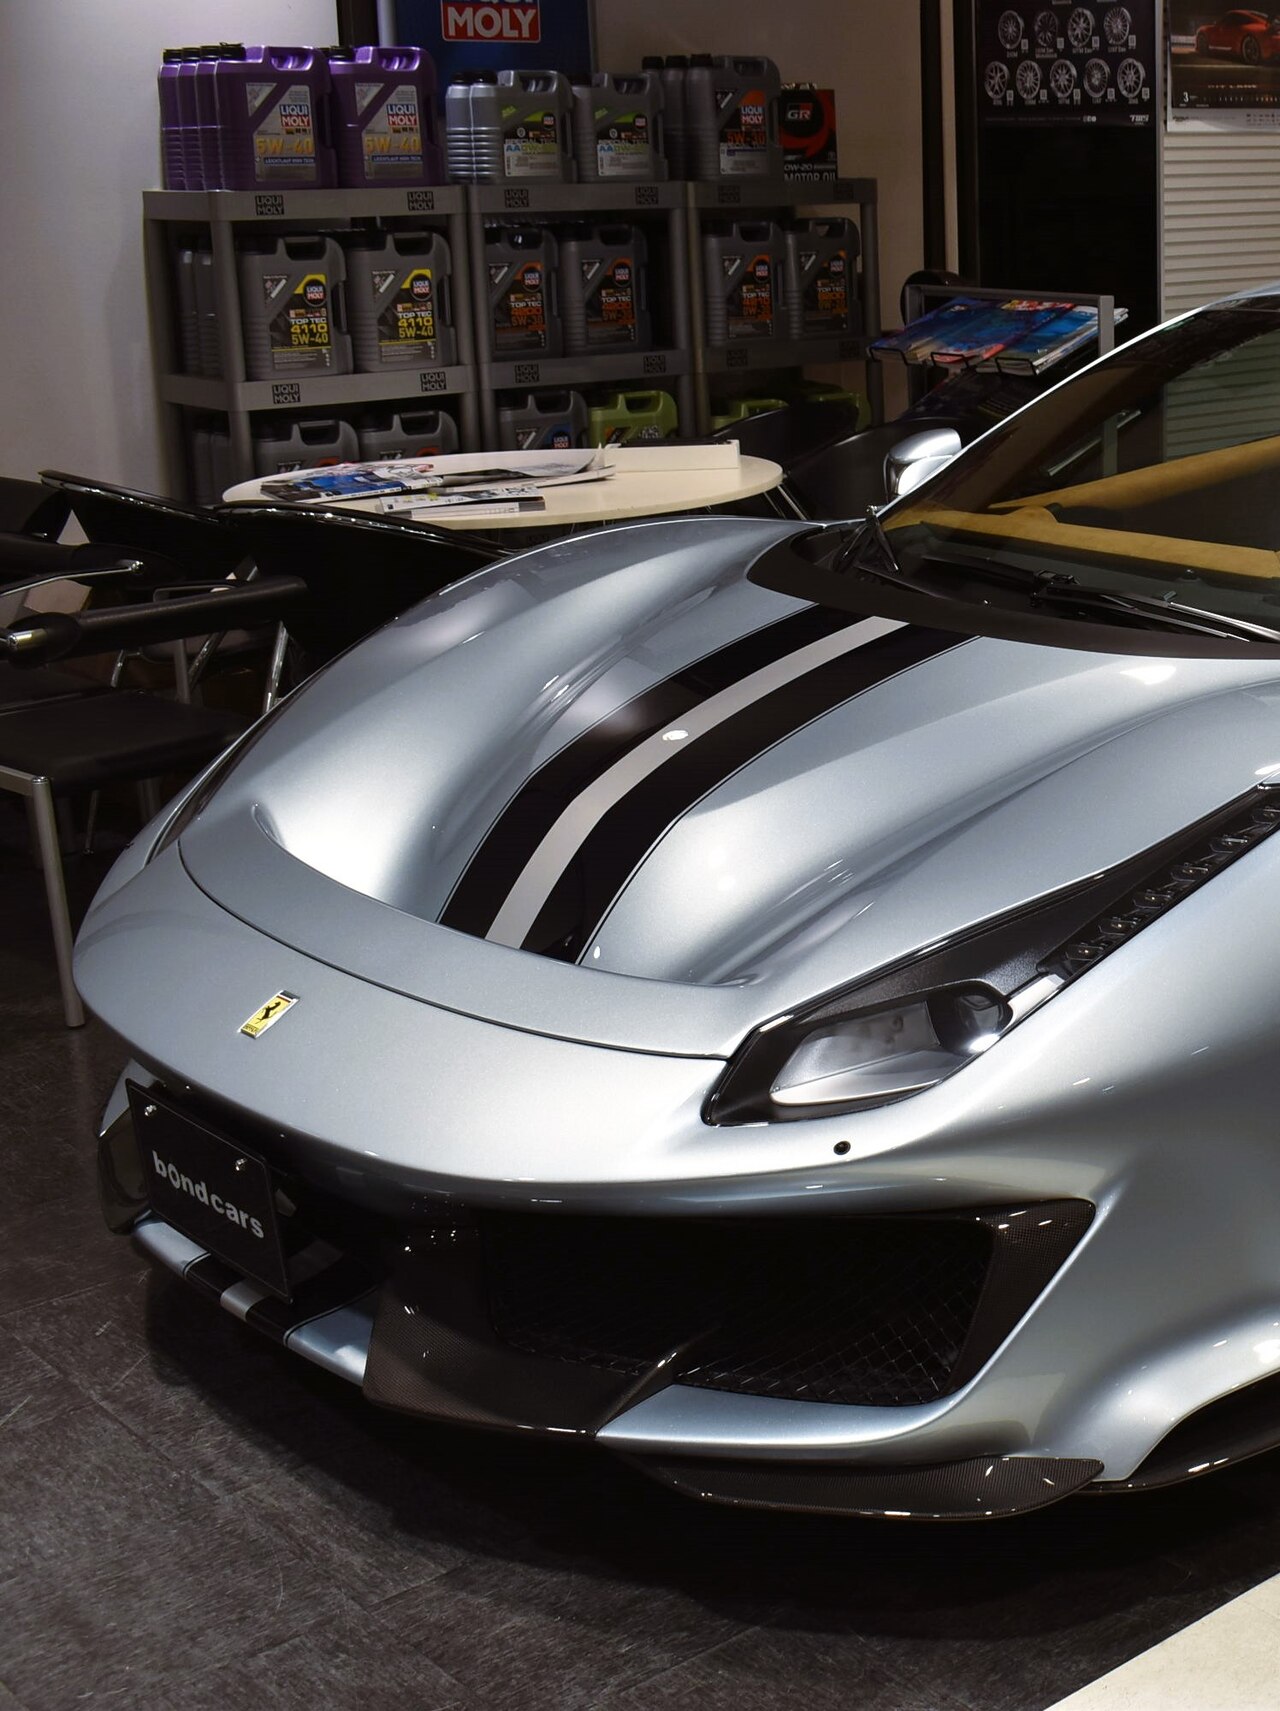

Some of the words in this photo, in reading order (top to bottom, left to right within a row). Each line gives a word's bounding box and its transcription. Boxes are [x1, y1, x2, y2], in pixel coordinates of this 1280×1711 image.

[447, 6, 536, 38] MOLY
[281, 105, 309, 115] LIQUI
[388, 105, 415, 114] LIQUI
[787, 109, 811, 119] GR
[282, 116, 310, 127] MOLY
[389, 115, 417, 125] MOLY
[741, 115, 764, 123] MOLY
[256, 138, 315, 155] 5W-40
[366, 137, 421, 153] 5W-40
[255, 195, 284, 206] LIQUI
[408, 191, 433, 201] LIQUI
[257, 205, 285, 215] MOLY
[409, 200, 435, 210] MOLY
[398, 317, 433, 327] 4110
[290, 323, 328, 333] 4110
[399, 326, 434, 338] 5W-40
[291, 333, 329, 345] 5W-40
[420, 371, 446, 382] LIQUI
[272, 383, 299, 394] LIQUI
[421, 381, 447, 392] MOLY
[273, 393, 301, 404] MOLY
